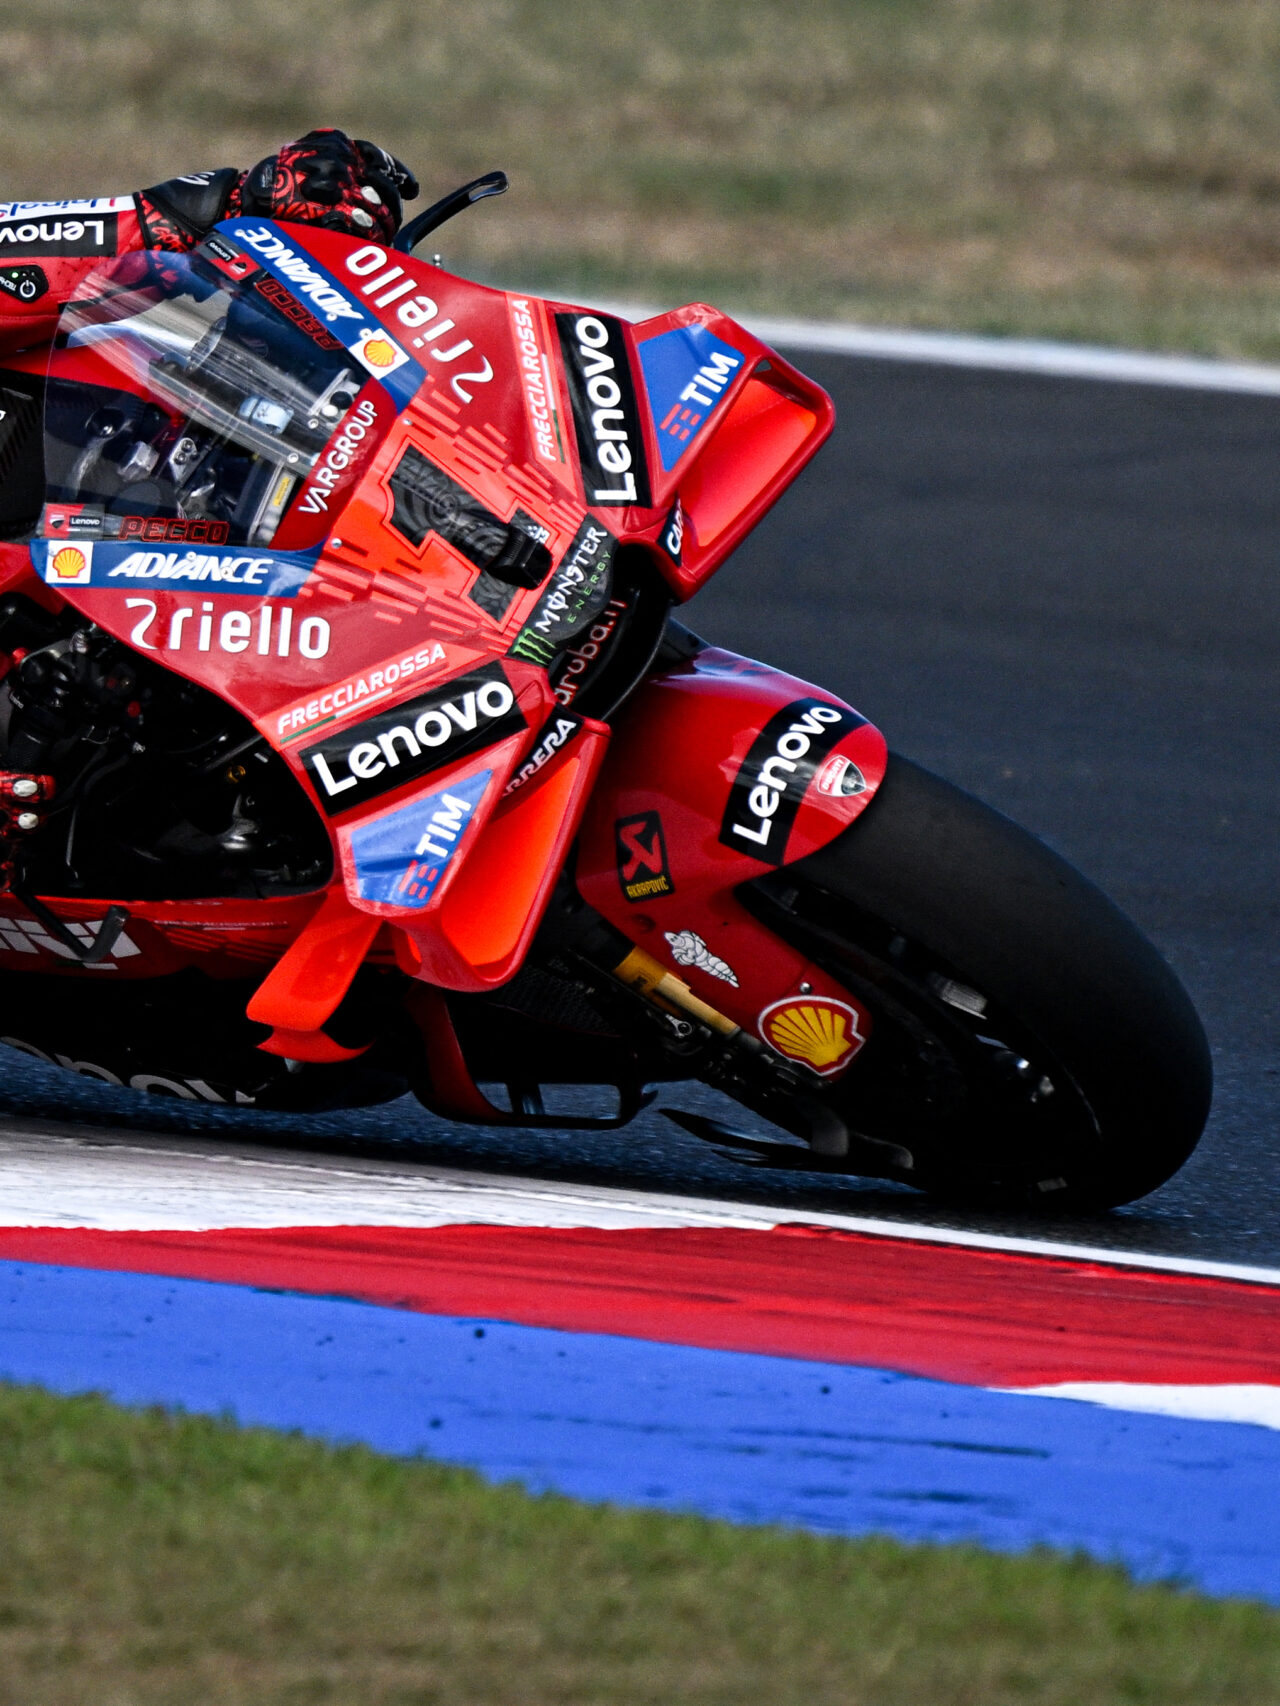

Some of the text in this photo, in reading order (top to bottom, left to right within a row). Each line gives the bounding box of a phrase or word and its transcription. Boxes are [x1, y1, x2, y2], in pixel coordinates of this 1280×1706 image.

[208, 241, 231, 262] Lenovo
[244, 226, 364, 320] ADVANCE
[254, 278, 345, 350] PECCO
[345, 245, 474, 362] riello
[512, 300, 556, 461] FRECCIAROSSA
[575, 316, 637, 501] Lenovo
[681, 351, 740, 406] TIM
[297, 400, 378, 514] VARGROUP
[71, 517, 101, 527] Lenovo
[118, 515, 231, 545] PECCO
[108, 551, 274, 585] ADVANCE
[535, 525, 608, 633] MONSTER
[567, 549, 612, 624] ENERGY
[168, 601, 331, 660] riello
[276, 643, 446, 736] FRECCIAROSSA
[311, 681, 514, 797] Lenovo
[502, 718, 577, 797] RRERA
[732, 706, 843, 846] Lenovo
[415, 792, 472, 861] TIM
